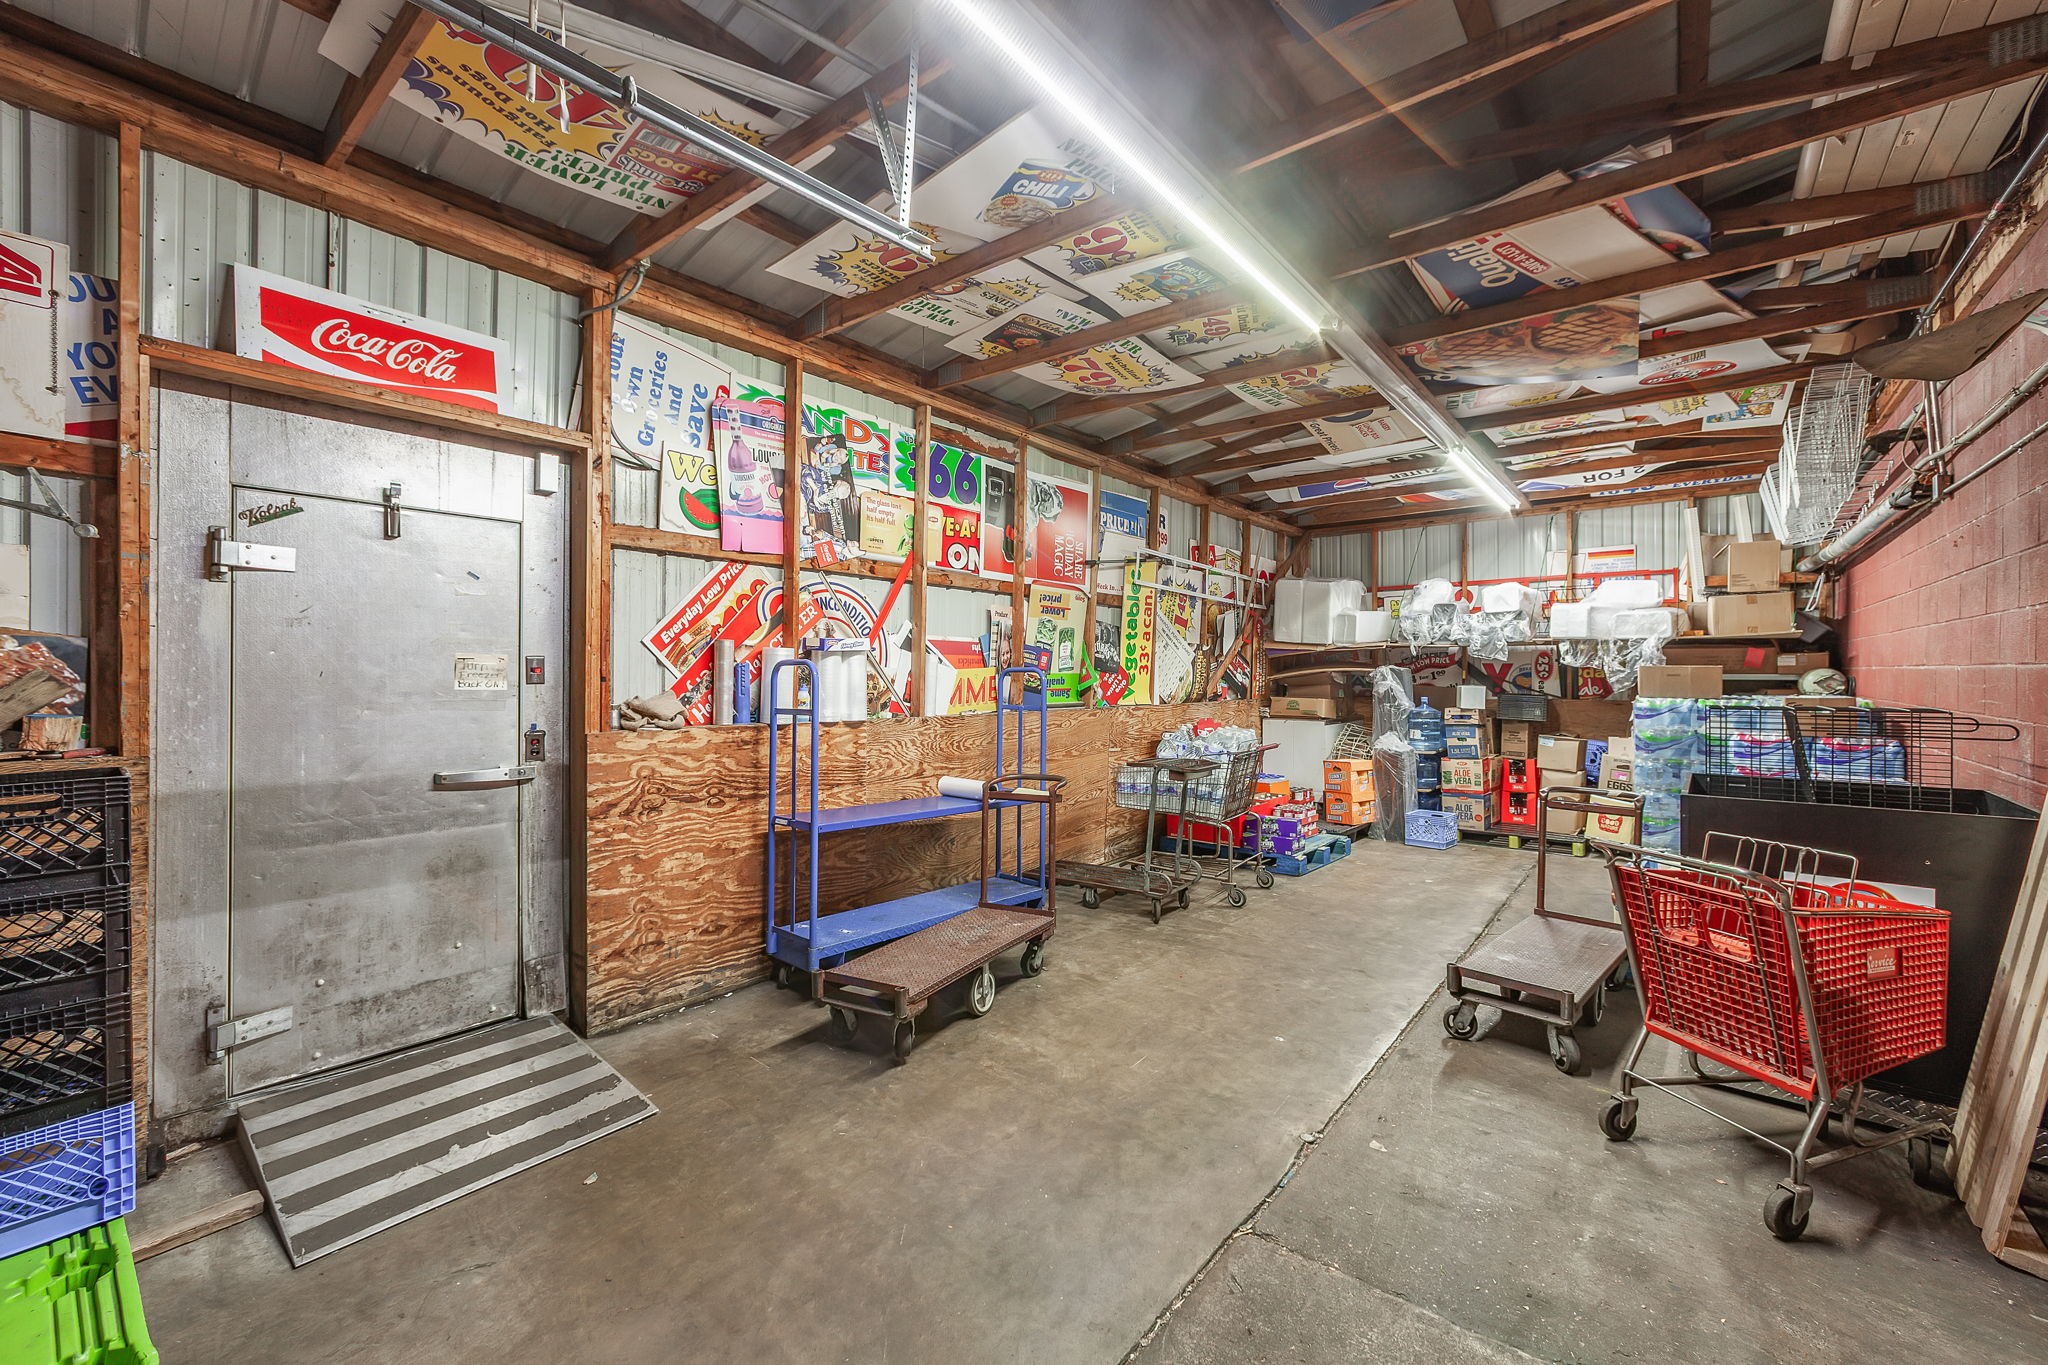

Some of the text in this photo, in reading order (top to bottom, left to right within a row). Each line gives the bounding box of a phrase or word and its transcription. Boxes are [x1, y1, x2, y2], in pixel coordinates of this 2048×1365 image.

[426, 56, 558, 147] Fairgrounds
[458, 63, 556, 132] Hot Dogs
[550, 150, 653, 192] PRICE!
[627, 148, 693, 176] DOGS
[504, 143, 673, 211] NEW LOWER
[1012, 179, 1069, 198] CHILI
[925, 311, 960, 327] NEW
[311, 318, 463, 383] Coca-Cola
[637, 350, 668, 446] Groceries
[680, 383, 709, 449] Save
[1583, 469, 1626, 484] FOR
[879, 509, 895, 518] empty
[1053, 535, 1063, 577] MAGIC
[1075, 541, 1084, 579] SHARE
[660, 601, 704, 644] Everyday
[700, 581, 722, 605] Low
[718, 561, 746, 586] Price
[1039, 594, 1062, 604] price!
[1040, 608, 1066, 618] Lower
[1122, 562, 1143, 700] Vegetable
[1046, 677, 1065, 690] quali
[1050, 690, 1070, 698] Same
[1454, 769, 1471, 777] ALOE
[1454, 777, 1472, 785] VERA
[1607, 780, 1633, 792] EGGS
[1455, 804, 1473, 812] ALOE
[1456, 812, 1474, 821] VERA
